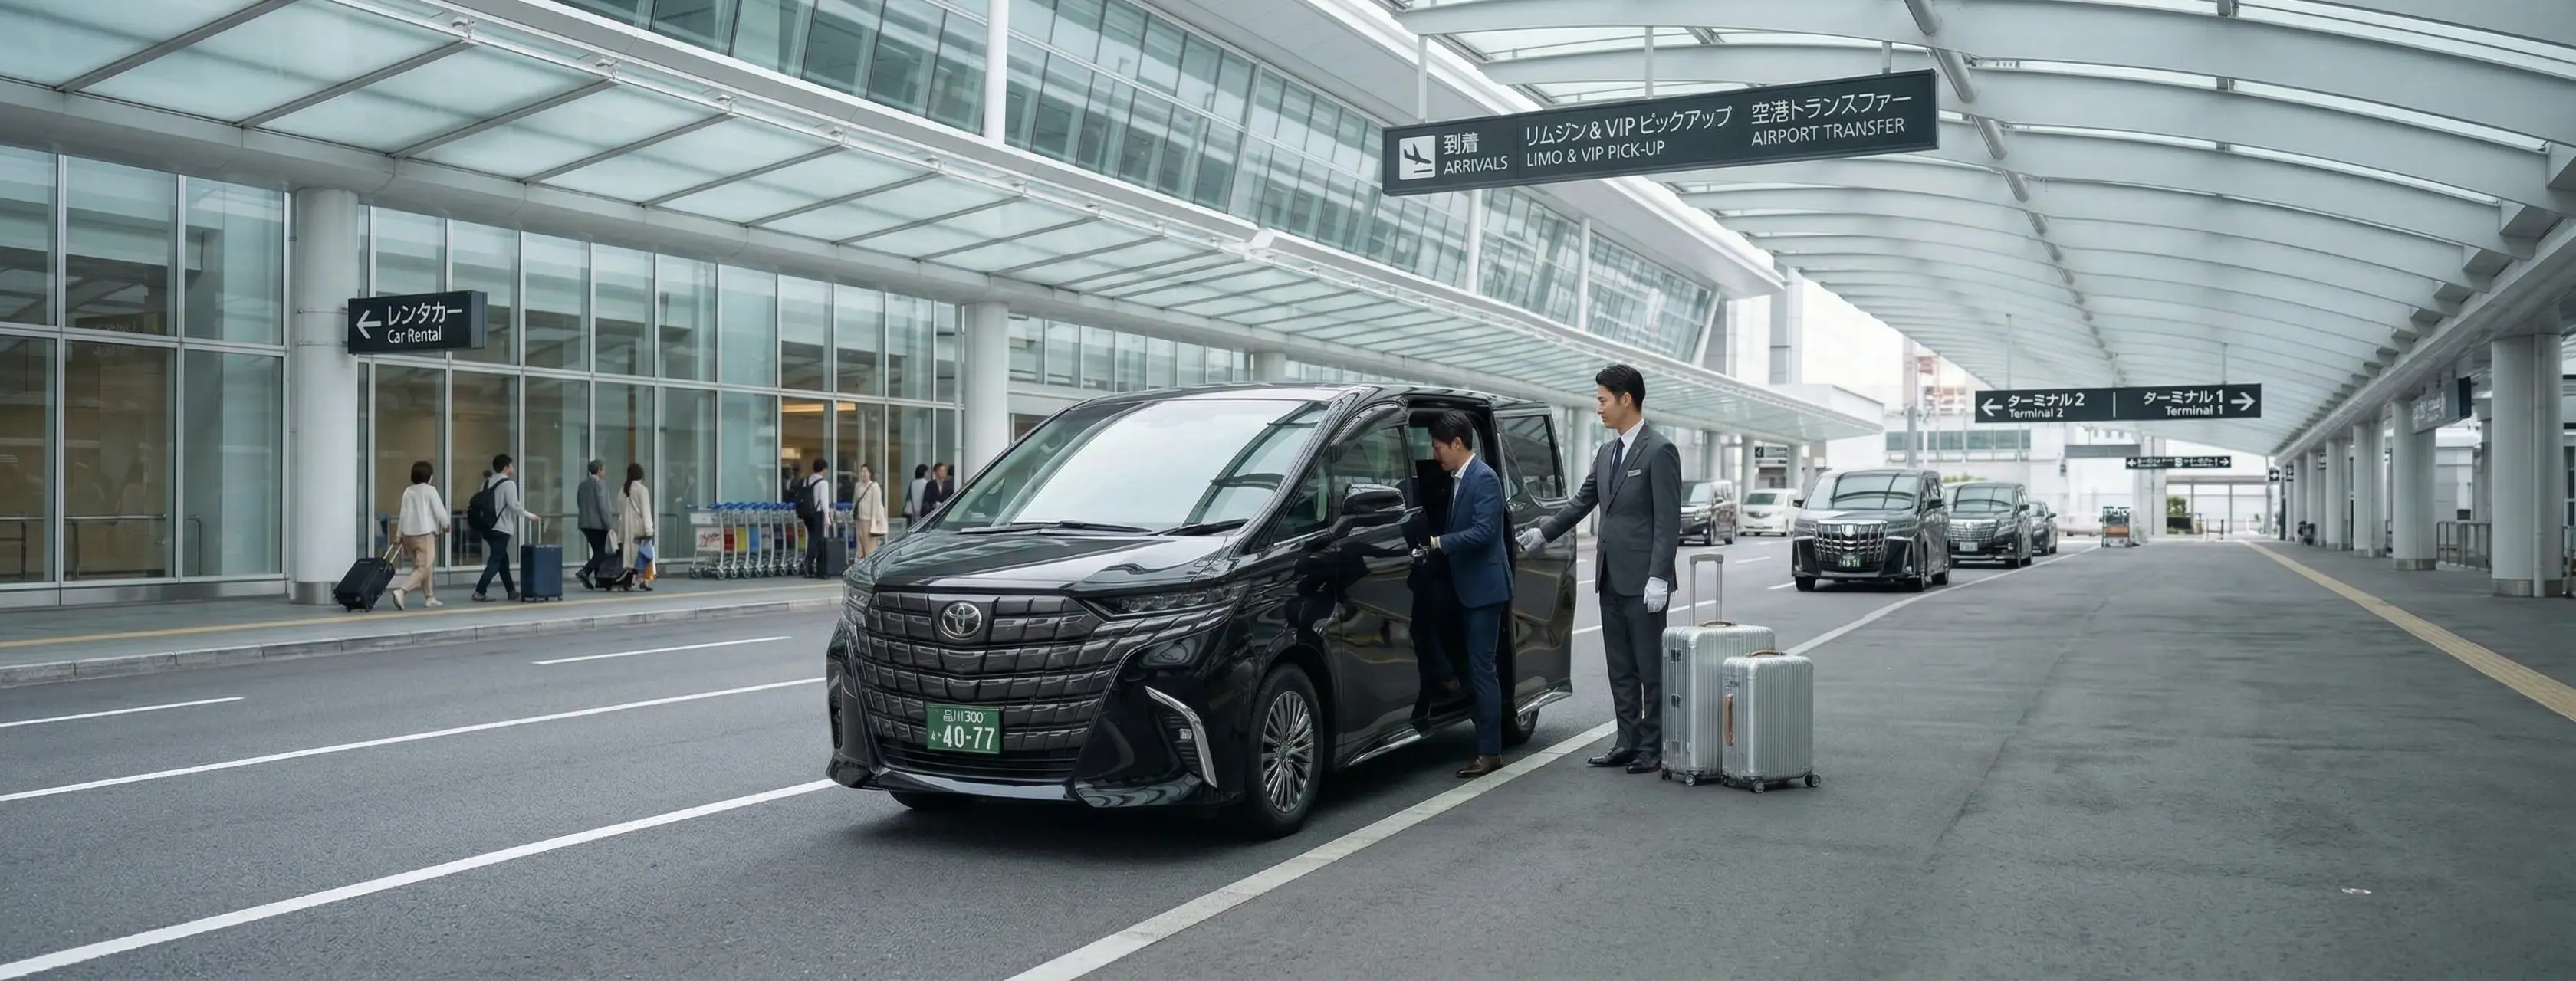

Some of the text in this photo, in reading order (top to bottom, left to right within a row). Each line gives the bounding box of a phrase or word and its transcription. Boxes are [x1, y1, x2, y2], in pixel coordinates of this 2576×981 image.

[1640, 104, 1733, 135] ピックアップ
[1751, 92, 1911, 125] 空港トランスファー
[1444, 132, 1479, 156] 到着
[1751, 117, 1905, 146] AIRPORT TRANSFER
[1444, 155, 1508, 176] ARRIVALS
[1526, 140, 1665, 167] LIMO & VIP PICK-UP
[388, 301, 462, 326] レンタカー
[387, 325, 442, 343] Car Rental
[2009, 408, 2064, 418] Terminal 2
[2165, 405, 2223, 416] Terminal 1
[942, 725, 995, 750] 40-77
